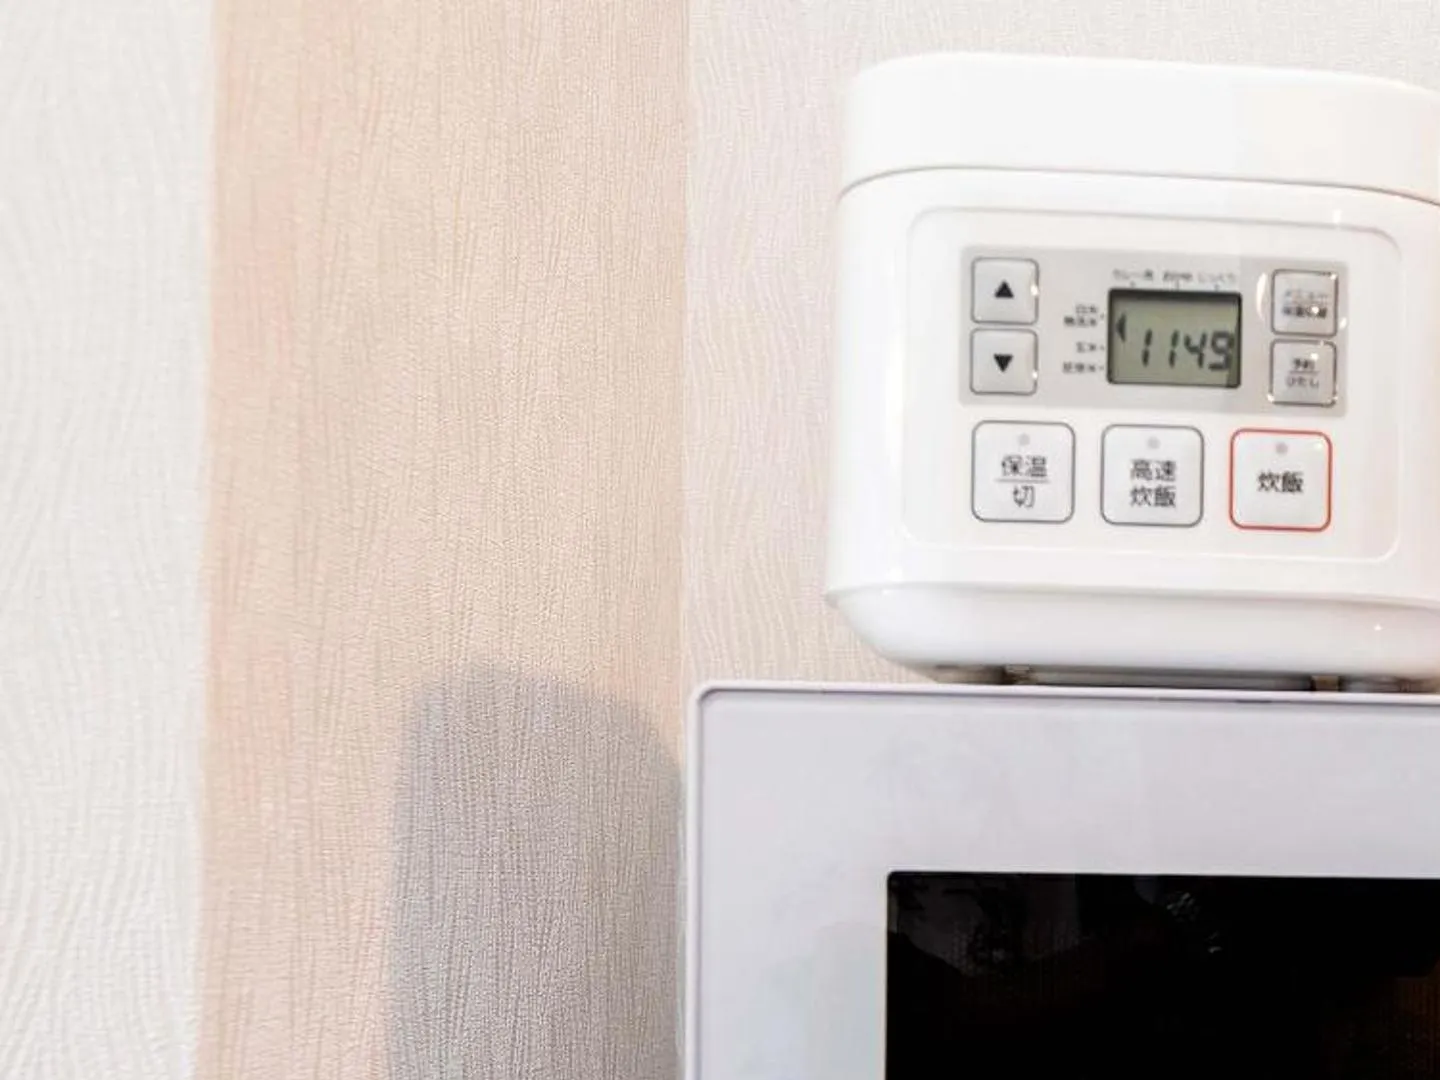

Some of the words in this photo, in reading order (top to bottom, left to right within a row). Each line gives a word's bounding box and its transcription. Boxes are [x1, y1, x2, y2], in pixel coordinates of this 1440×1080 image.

[1001, 454, 1048, 479] 保温
[1130, 458, 1177, 482] 高速
[1257, 471, 1304, 495] 炊飯
[1012, 485, 1036, 508] 切
[1130, 486, 1177, 509] 炊飯
